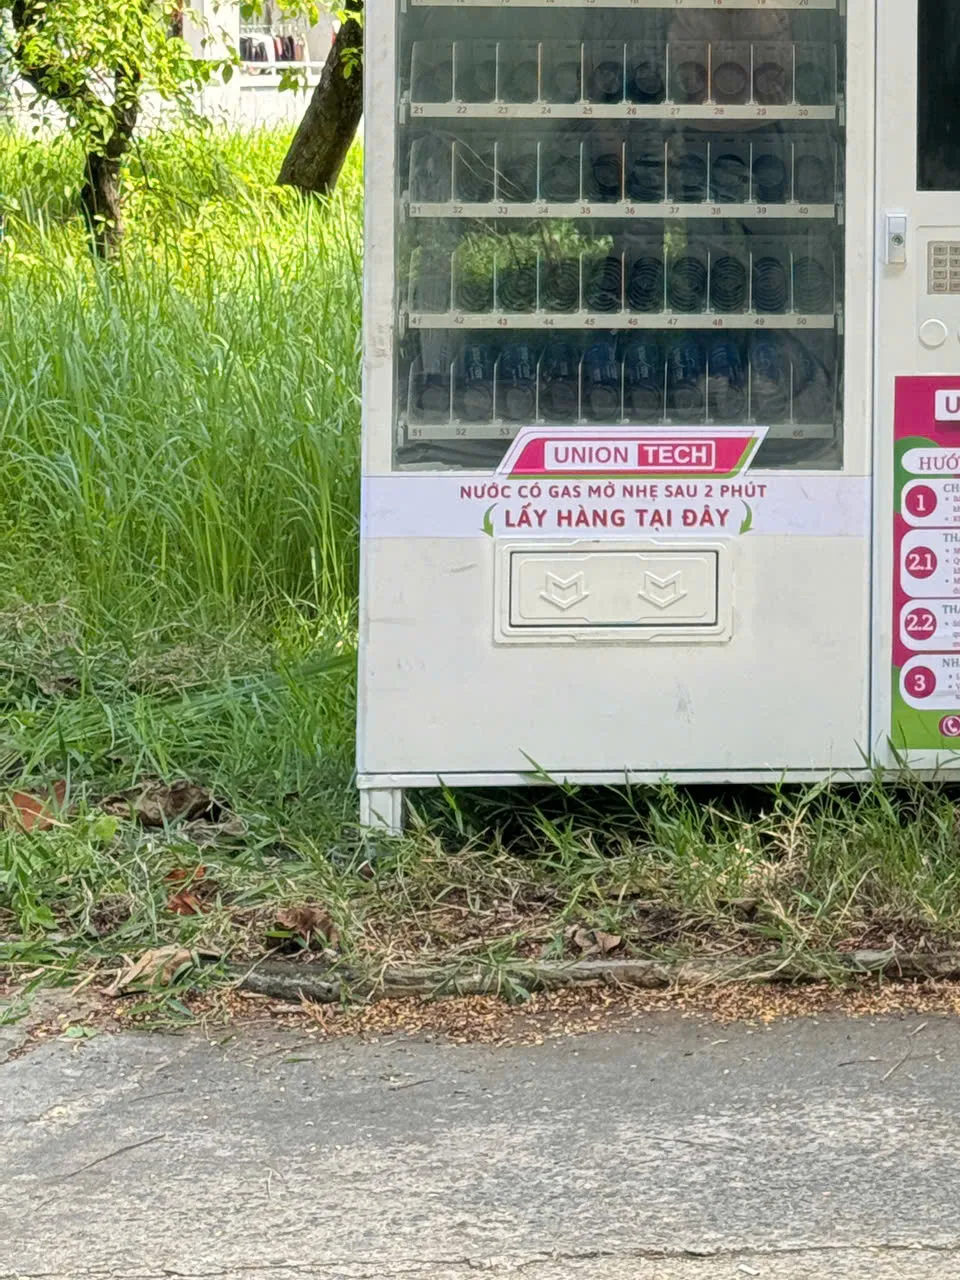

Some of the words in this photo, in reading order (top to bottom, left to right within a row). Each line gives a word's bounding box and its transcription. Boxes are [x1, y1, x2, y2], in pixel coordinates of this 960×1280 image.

[554, 447, 628, 463] UNION
[644, 446, 706, 463] TECH
[460, 484, 510, 499] NƯỚC
[518, 483, 541, 498] CÓ
[549, 485, 581, 498] GAS
[588, 483, 616, 498] MỞ
[623, 485, 658, 501] NHẸ
[664, 485, 697, 498] SAU
[705, 485, 713, 498] 2
[721, 482, 767, 498] PHÚT
[916, 494, 926, 511] 1
[505, 502, 547, 527] LẤY
[557, 505, 625, 527] HÀNG
[635, 510, 671, 531] TẠI
[682, 506, 729, 527] ĐÂY
[908, 554, 933, 571] 2.1
[907, 615, 934, 632] 2.2
[914, 674, 926, 691] 3
